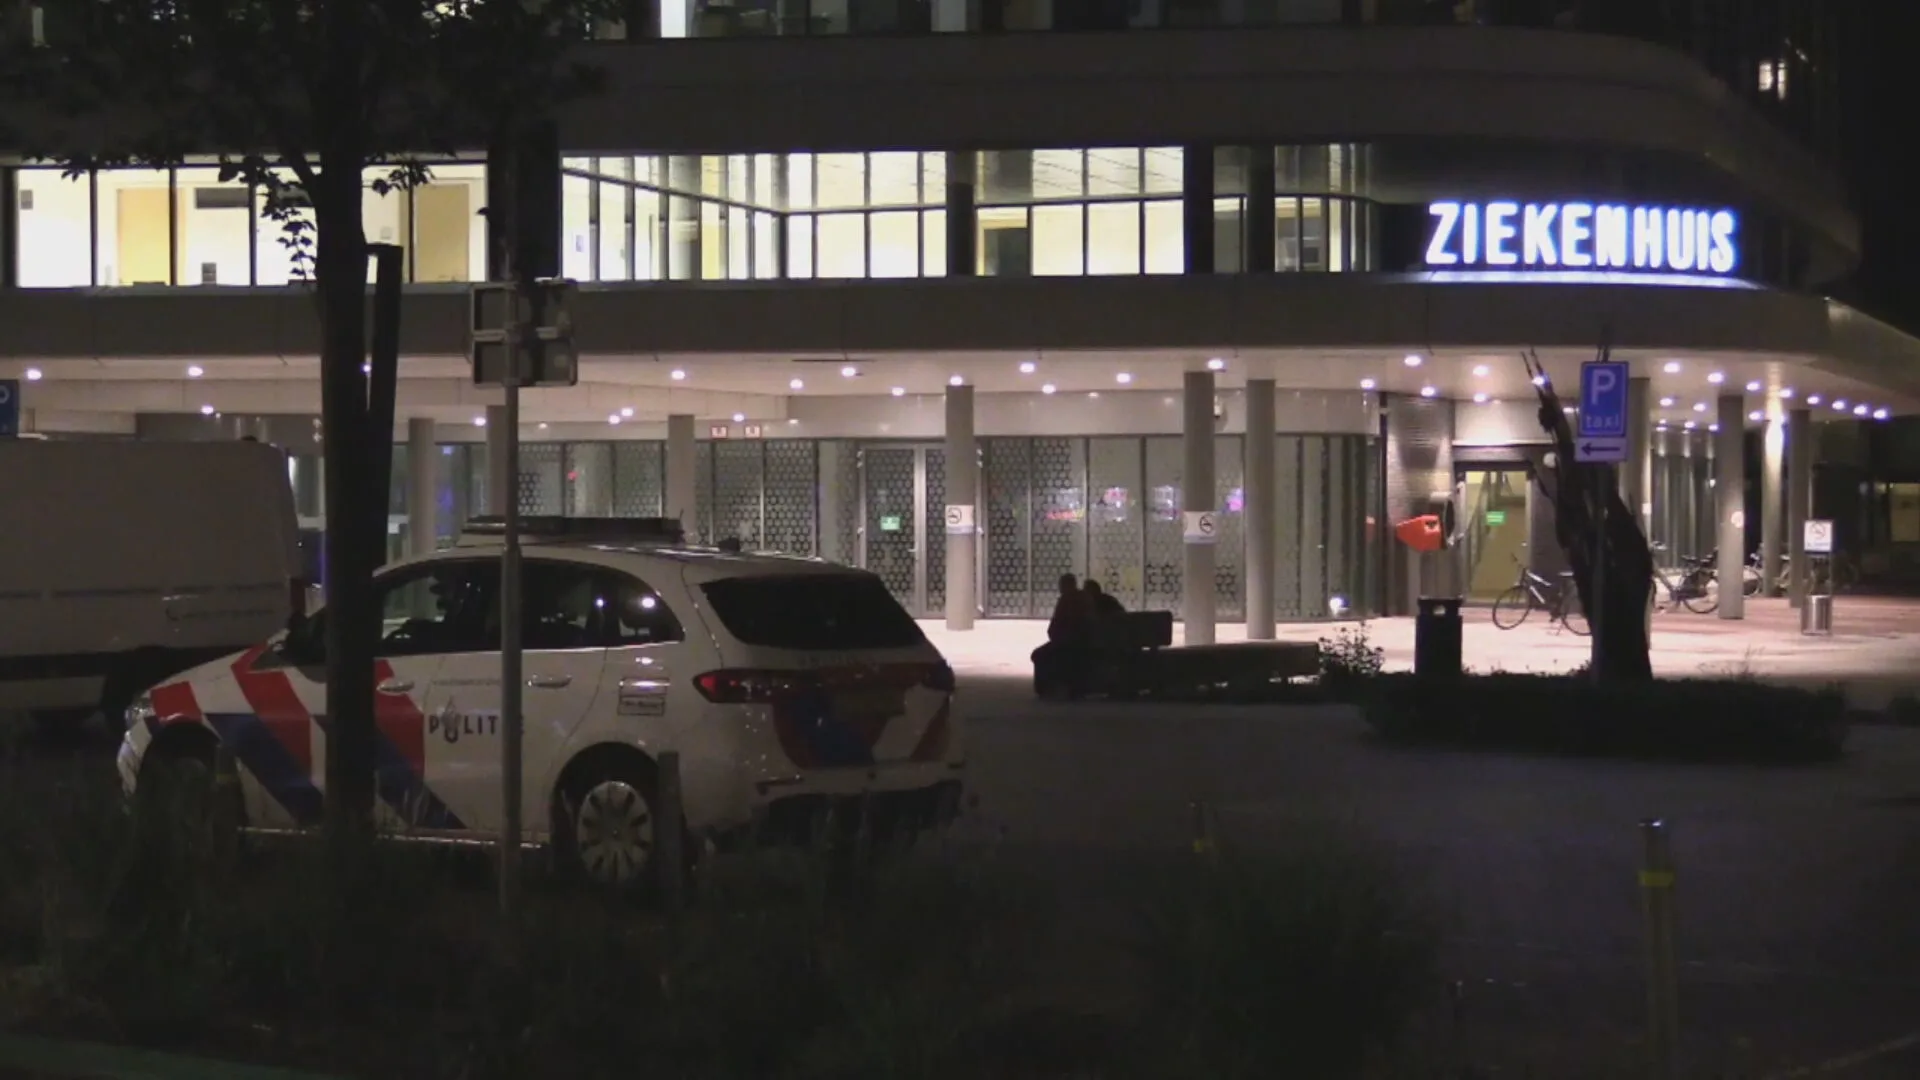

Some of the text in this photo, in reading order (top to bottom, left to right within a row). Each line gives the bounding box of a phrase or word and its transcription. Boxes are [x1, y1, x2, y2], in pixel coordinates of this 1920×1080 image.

[1425, 202, 1735, 272] ZIEKENHUIS
[1591, 368, 1616, 406] P
[1586, 414, 1619, 429] taxi
[428, 714, 524, 743] POLIT
